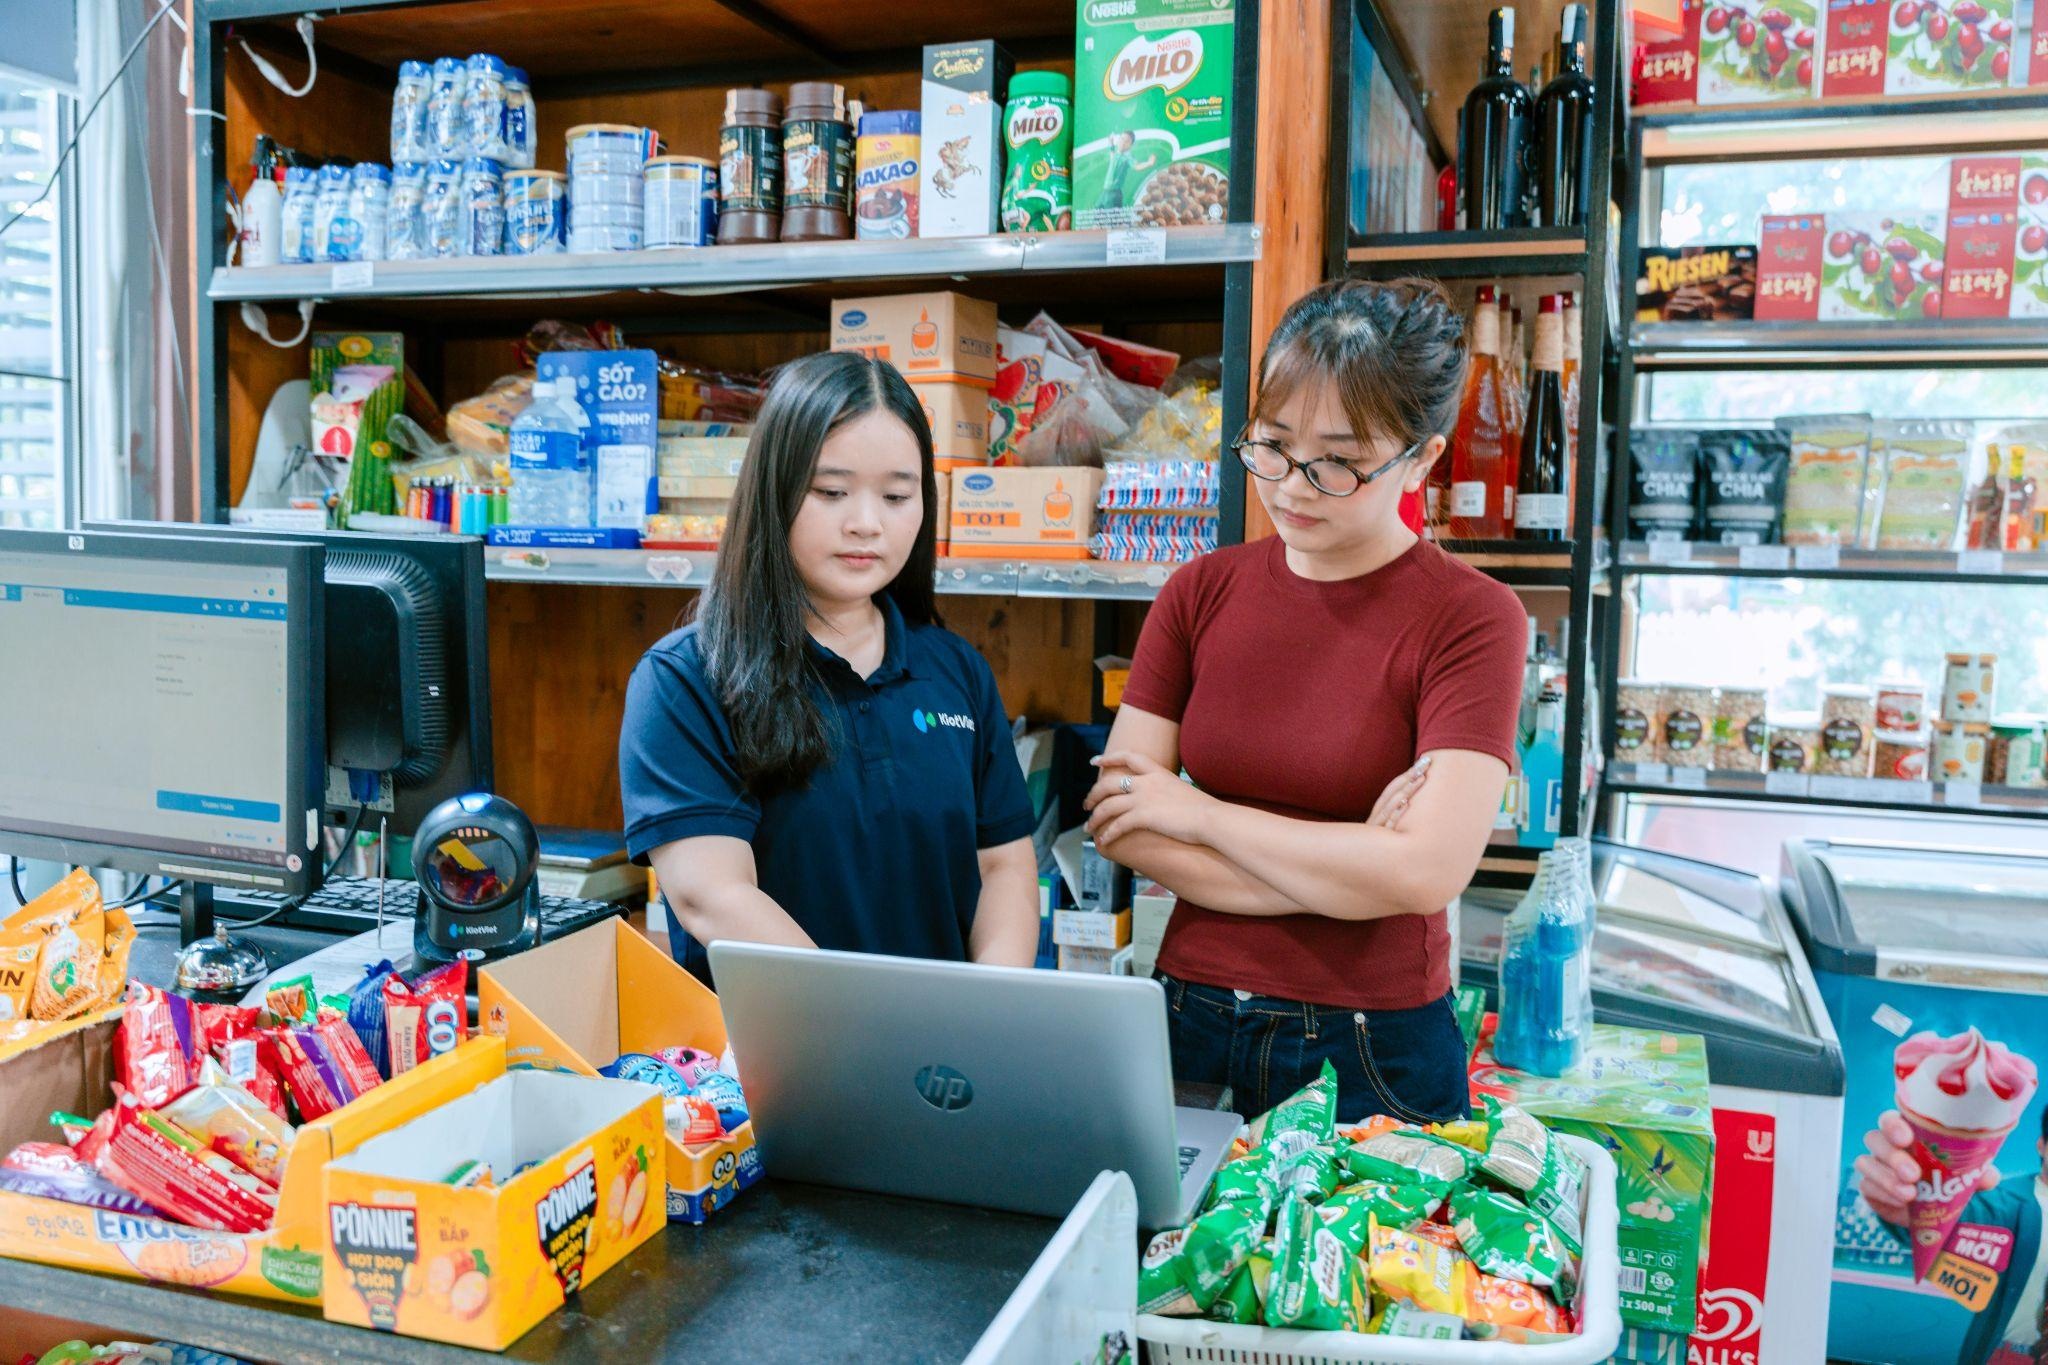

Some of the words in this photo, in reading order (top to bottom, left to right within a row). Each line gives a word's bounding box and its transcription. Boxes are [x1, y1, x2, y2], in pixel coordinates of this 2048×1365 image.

[1091, 1, 1137, 19] Nestlé
[1157, 38, 1191, 52] Nestlé
[1117, 50, 1194, 86] MILO
[1013, 116, 1058, 137] MILO
[1645, 250, 1729, 293] RIESEN
[598, 361, 635, 384] SỐT
[598, 383, 648, 401] CAO?
[1642, 481, 1689, 498] CHIA
[1718, 481, 1765, 498] CHIA
[550, 1230, 569, 1254] HOT
[569, 1213, 590, 1240] DOG
[267, 1257, 321, 1276] CHICKEN
[346, 1252, 373, 1269] HOT
[374, 1254, 405, 1272] DOG
[266, 1267, 320, 1289] FLAVOUR
[1634, 1299, 1656, 1312] 500
[1687, 1343, 1757, 1365] ALL'S
